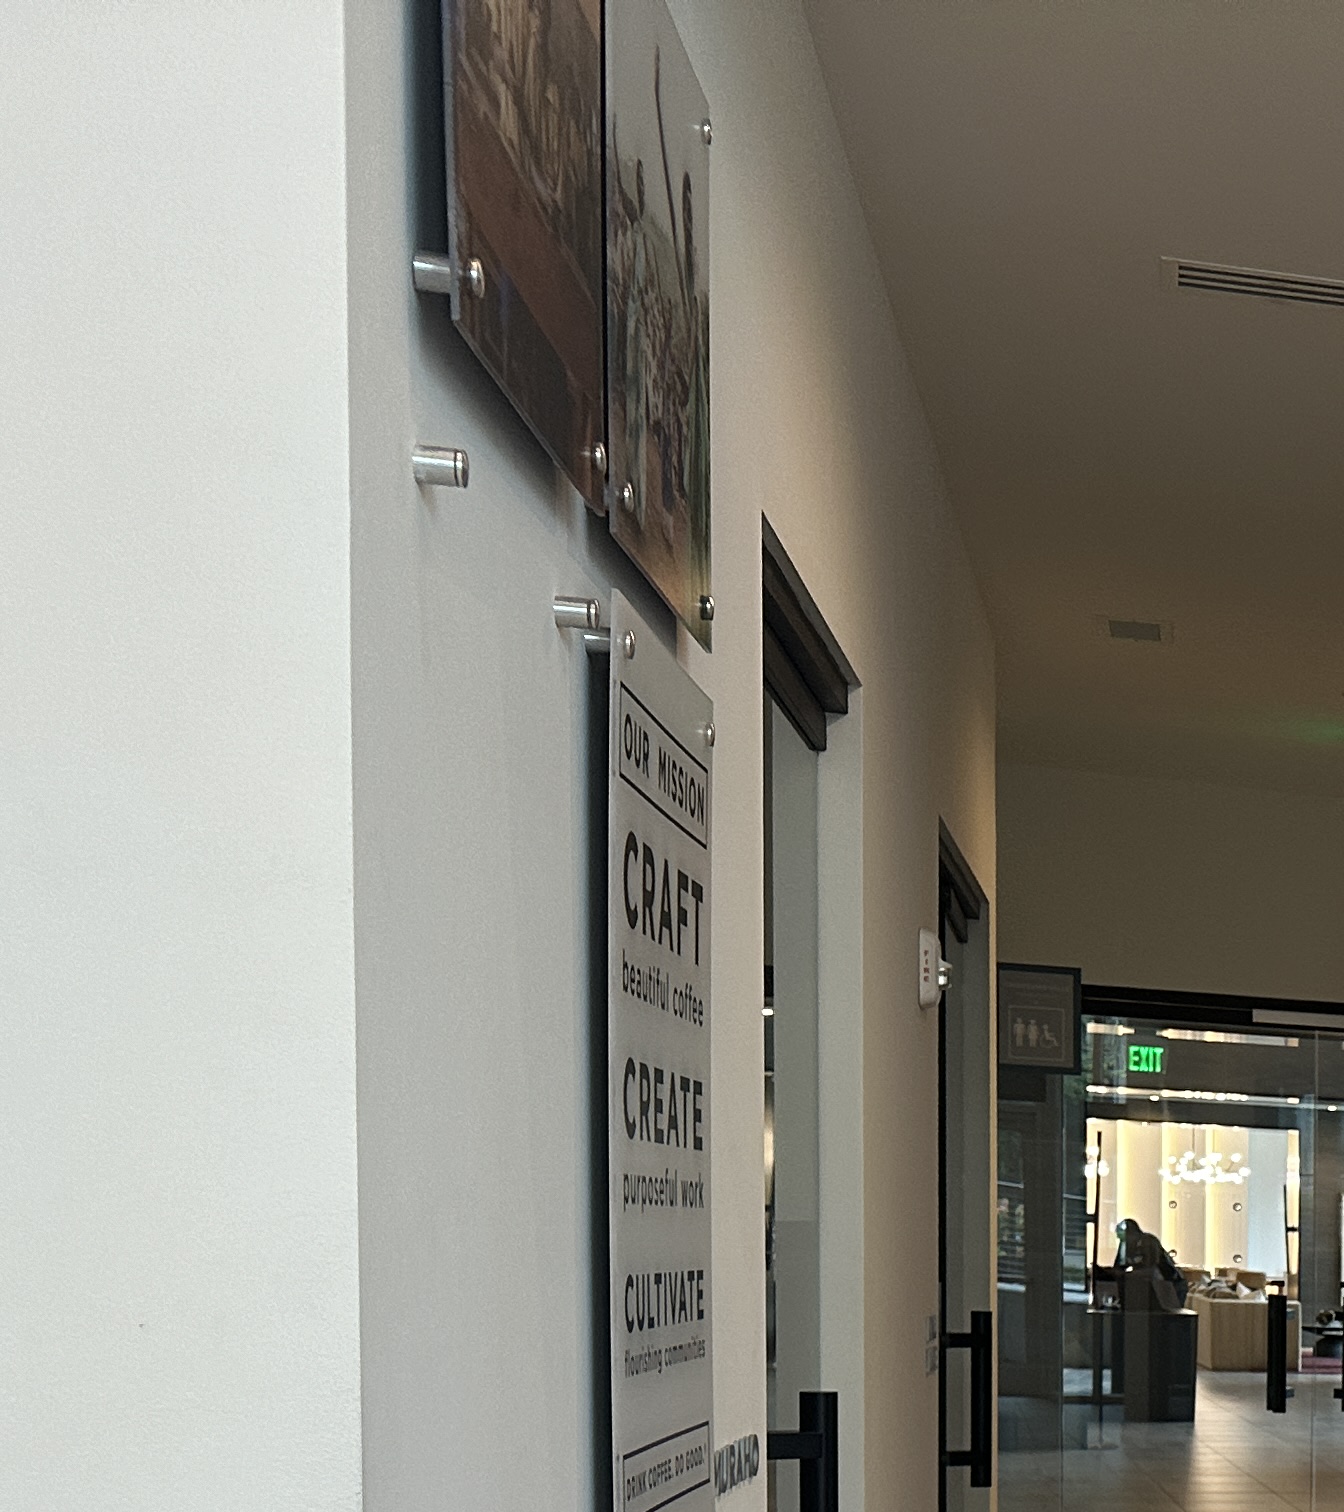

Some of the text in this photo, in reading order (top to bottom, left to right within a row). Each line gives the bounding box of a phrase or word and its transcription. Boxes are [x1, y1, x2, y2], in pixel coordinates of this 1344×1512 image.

[623, 712, 706, 827] OUR MISSION
[622, 830, 704, 967] CRAFT
[622, 948, 704, 1028] beautiful coffee
[1128, 1045, 1164, 1073] EXIT
[622, 1056, 704, 1151] CREATE
[622, 1169, 705, 1213] purposeful work
[623, 1269, 705, 1334] CULTIVATE
[624, 1343, 663, 1378] flourishing
[626, 1469, 647, 1501] DRINK
[675, 1453, 684, 1476] DO
